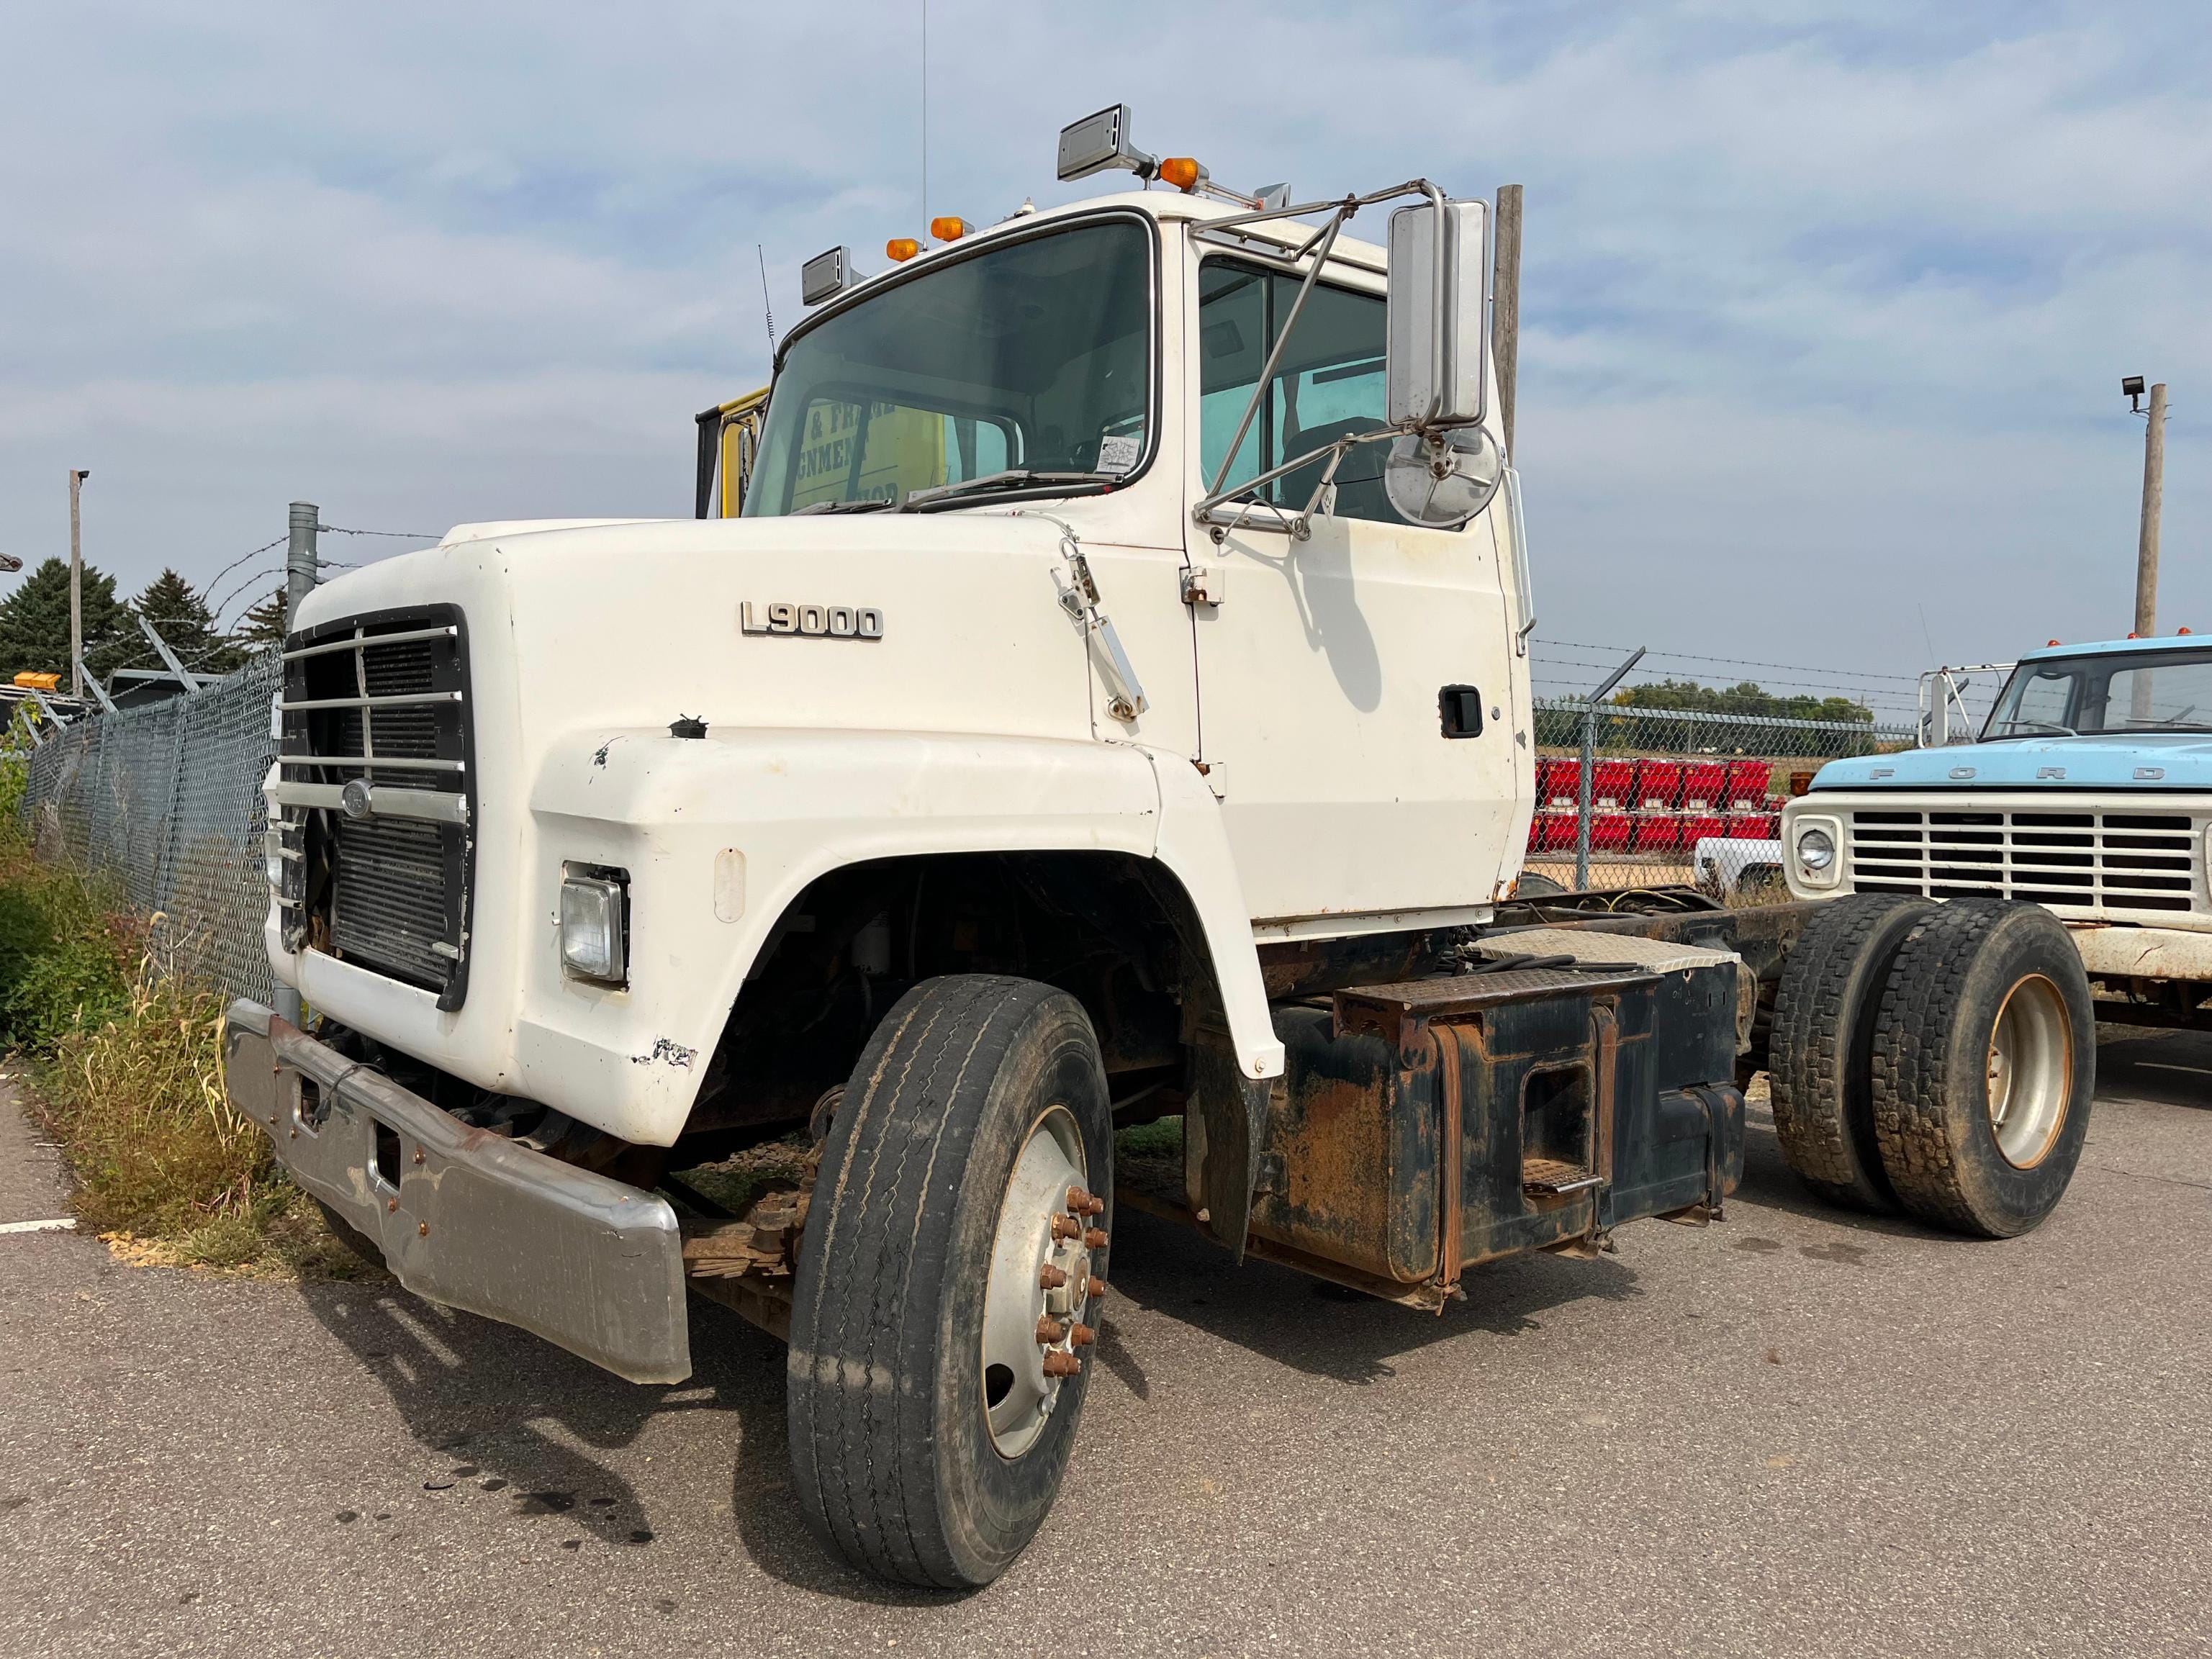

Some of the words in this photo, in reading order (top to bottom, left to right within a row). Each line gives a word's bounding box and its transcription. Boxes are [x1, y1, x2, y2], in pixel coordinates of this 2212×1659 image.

[811, 411, 822, 440] &
[741, 601, 884, 639] L9000
[1869, 767, 2165, 779] FORD
